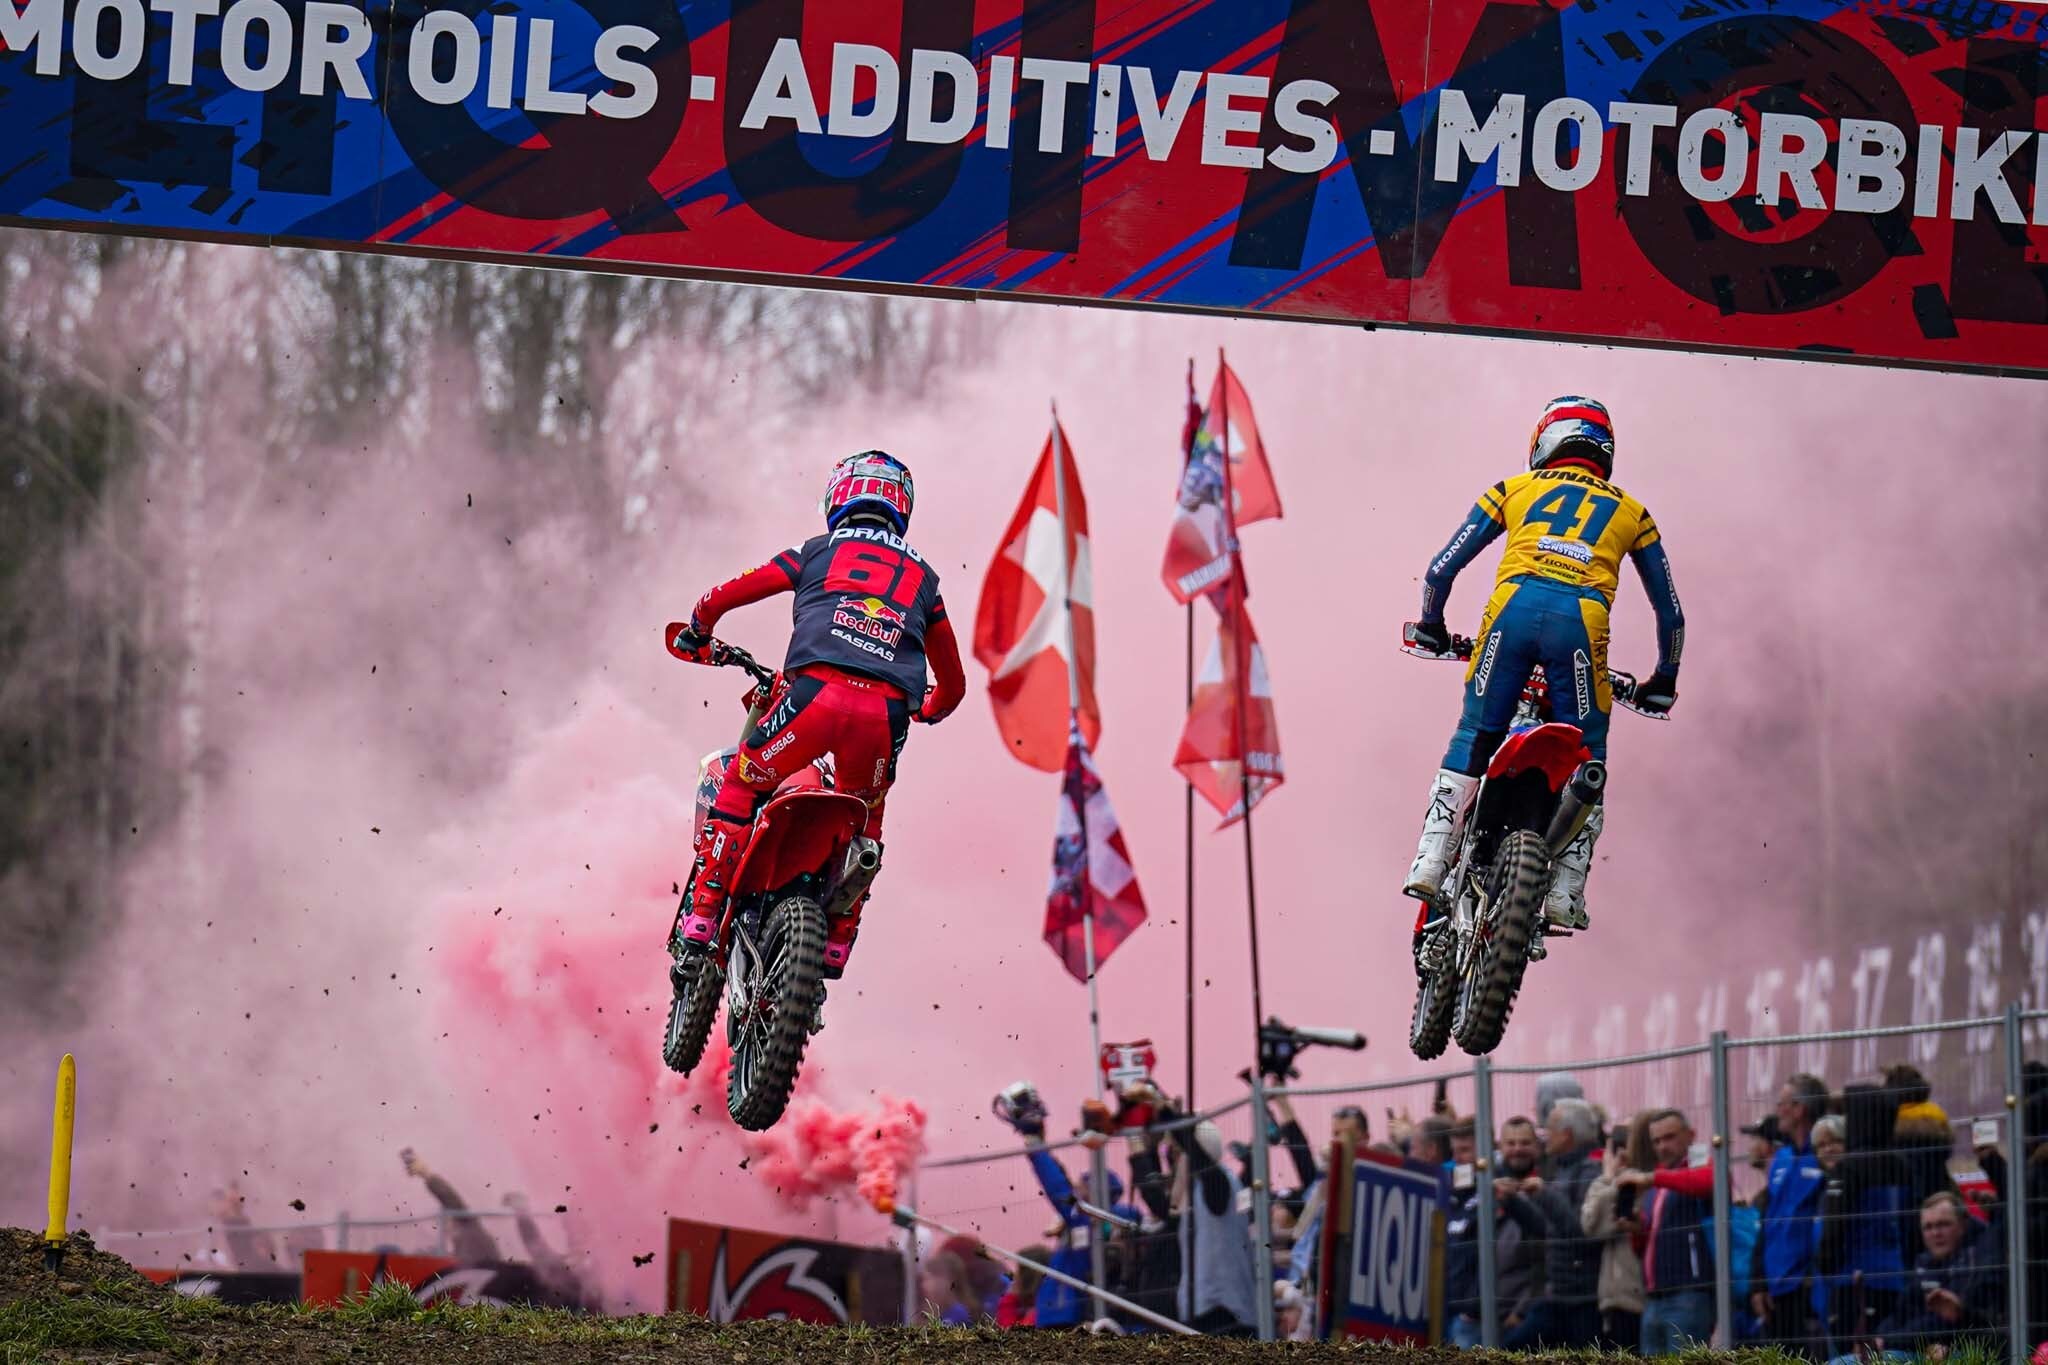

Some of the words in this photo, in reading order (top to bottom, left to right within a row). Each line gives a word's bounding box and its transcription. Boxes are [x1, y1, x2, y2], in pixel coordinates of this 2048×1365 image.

[0, 0, 373, 100] MOTOR
[408, 10, 661, 120] OILS
[740, 37, 1341, 174] ADDITIVES
[1522, 483, 1621, 547] 41
[1432, 523, 1478, 575] HONDA
[1543, 558, 1587, 576] HONDA
[823, 540, 926, 609] 61
[831, 628, 895, 662] GASGAS
[832, 610, 870, 634] Red
[867, 618, 902, 649] Bull
[1480, 634, 1499, 682] HONDA
[1576, 667, 1588, 717] HONDA
[761, 731, 796, 761] GASGAS
